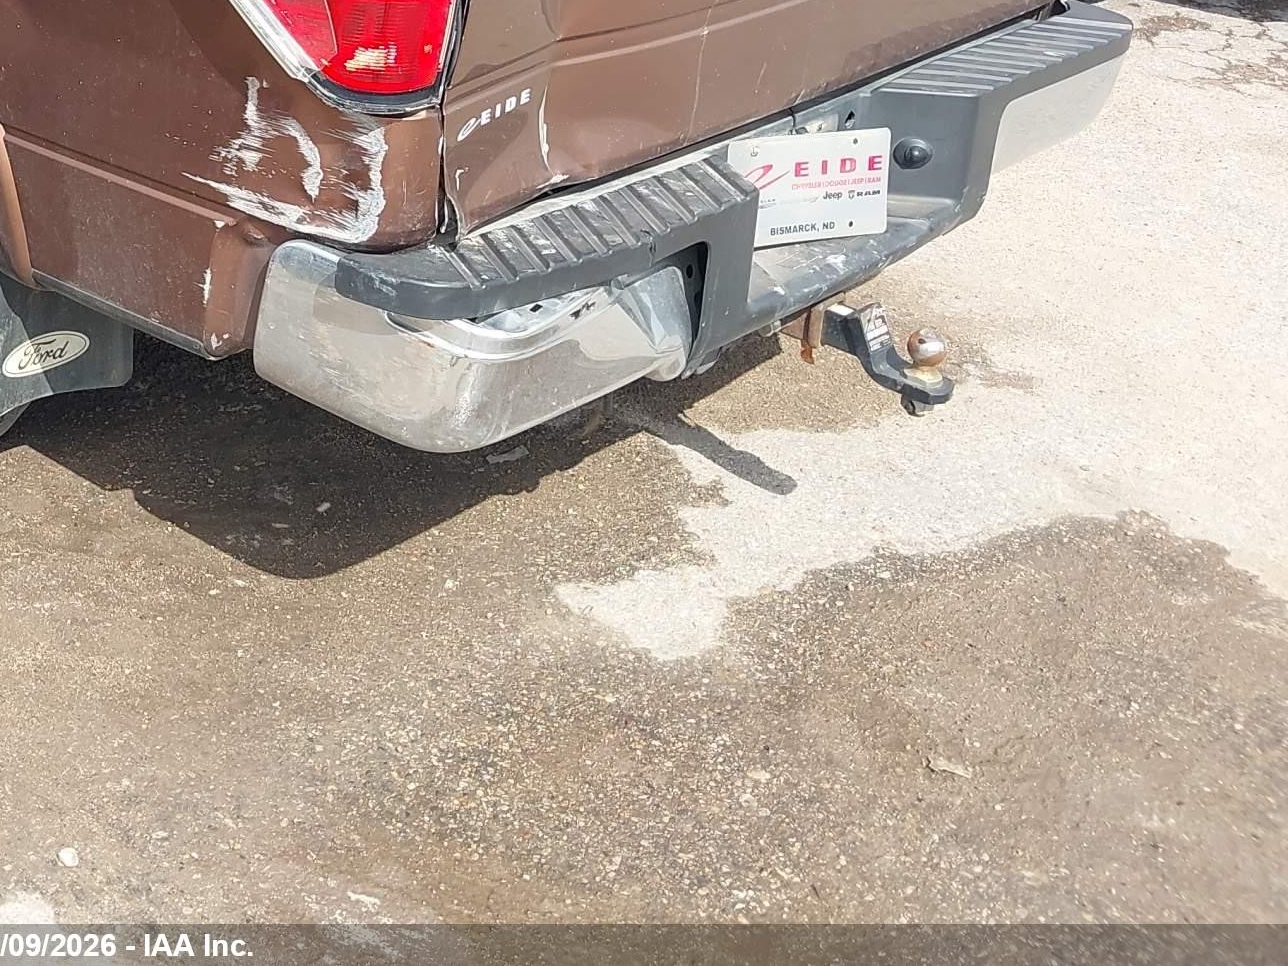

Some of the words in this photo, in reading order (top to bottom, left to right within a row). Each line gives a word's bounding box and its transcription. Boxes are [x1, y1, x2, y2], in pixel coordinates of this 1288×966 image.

[480, 88, 531, 126] EIDE
[794, 155, 883, 178] EIDE
[823, 191, 843, 200] Jeep
[770, 222, 820, 236] BISMARCK,
[822, 221, 836, 230] ND
[18, 338, 69, 370] Ford
